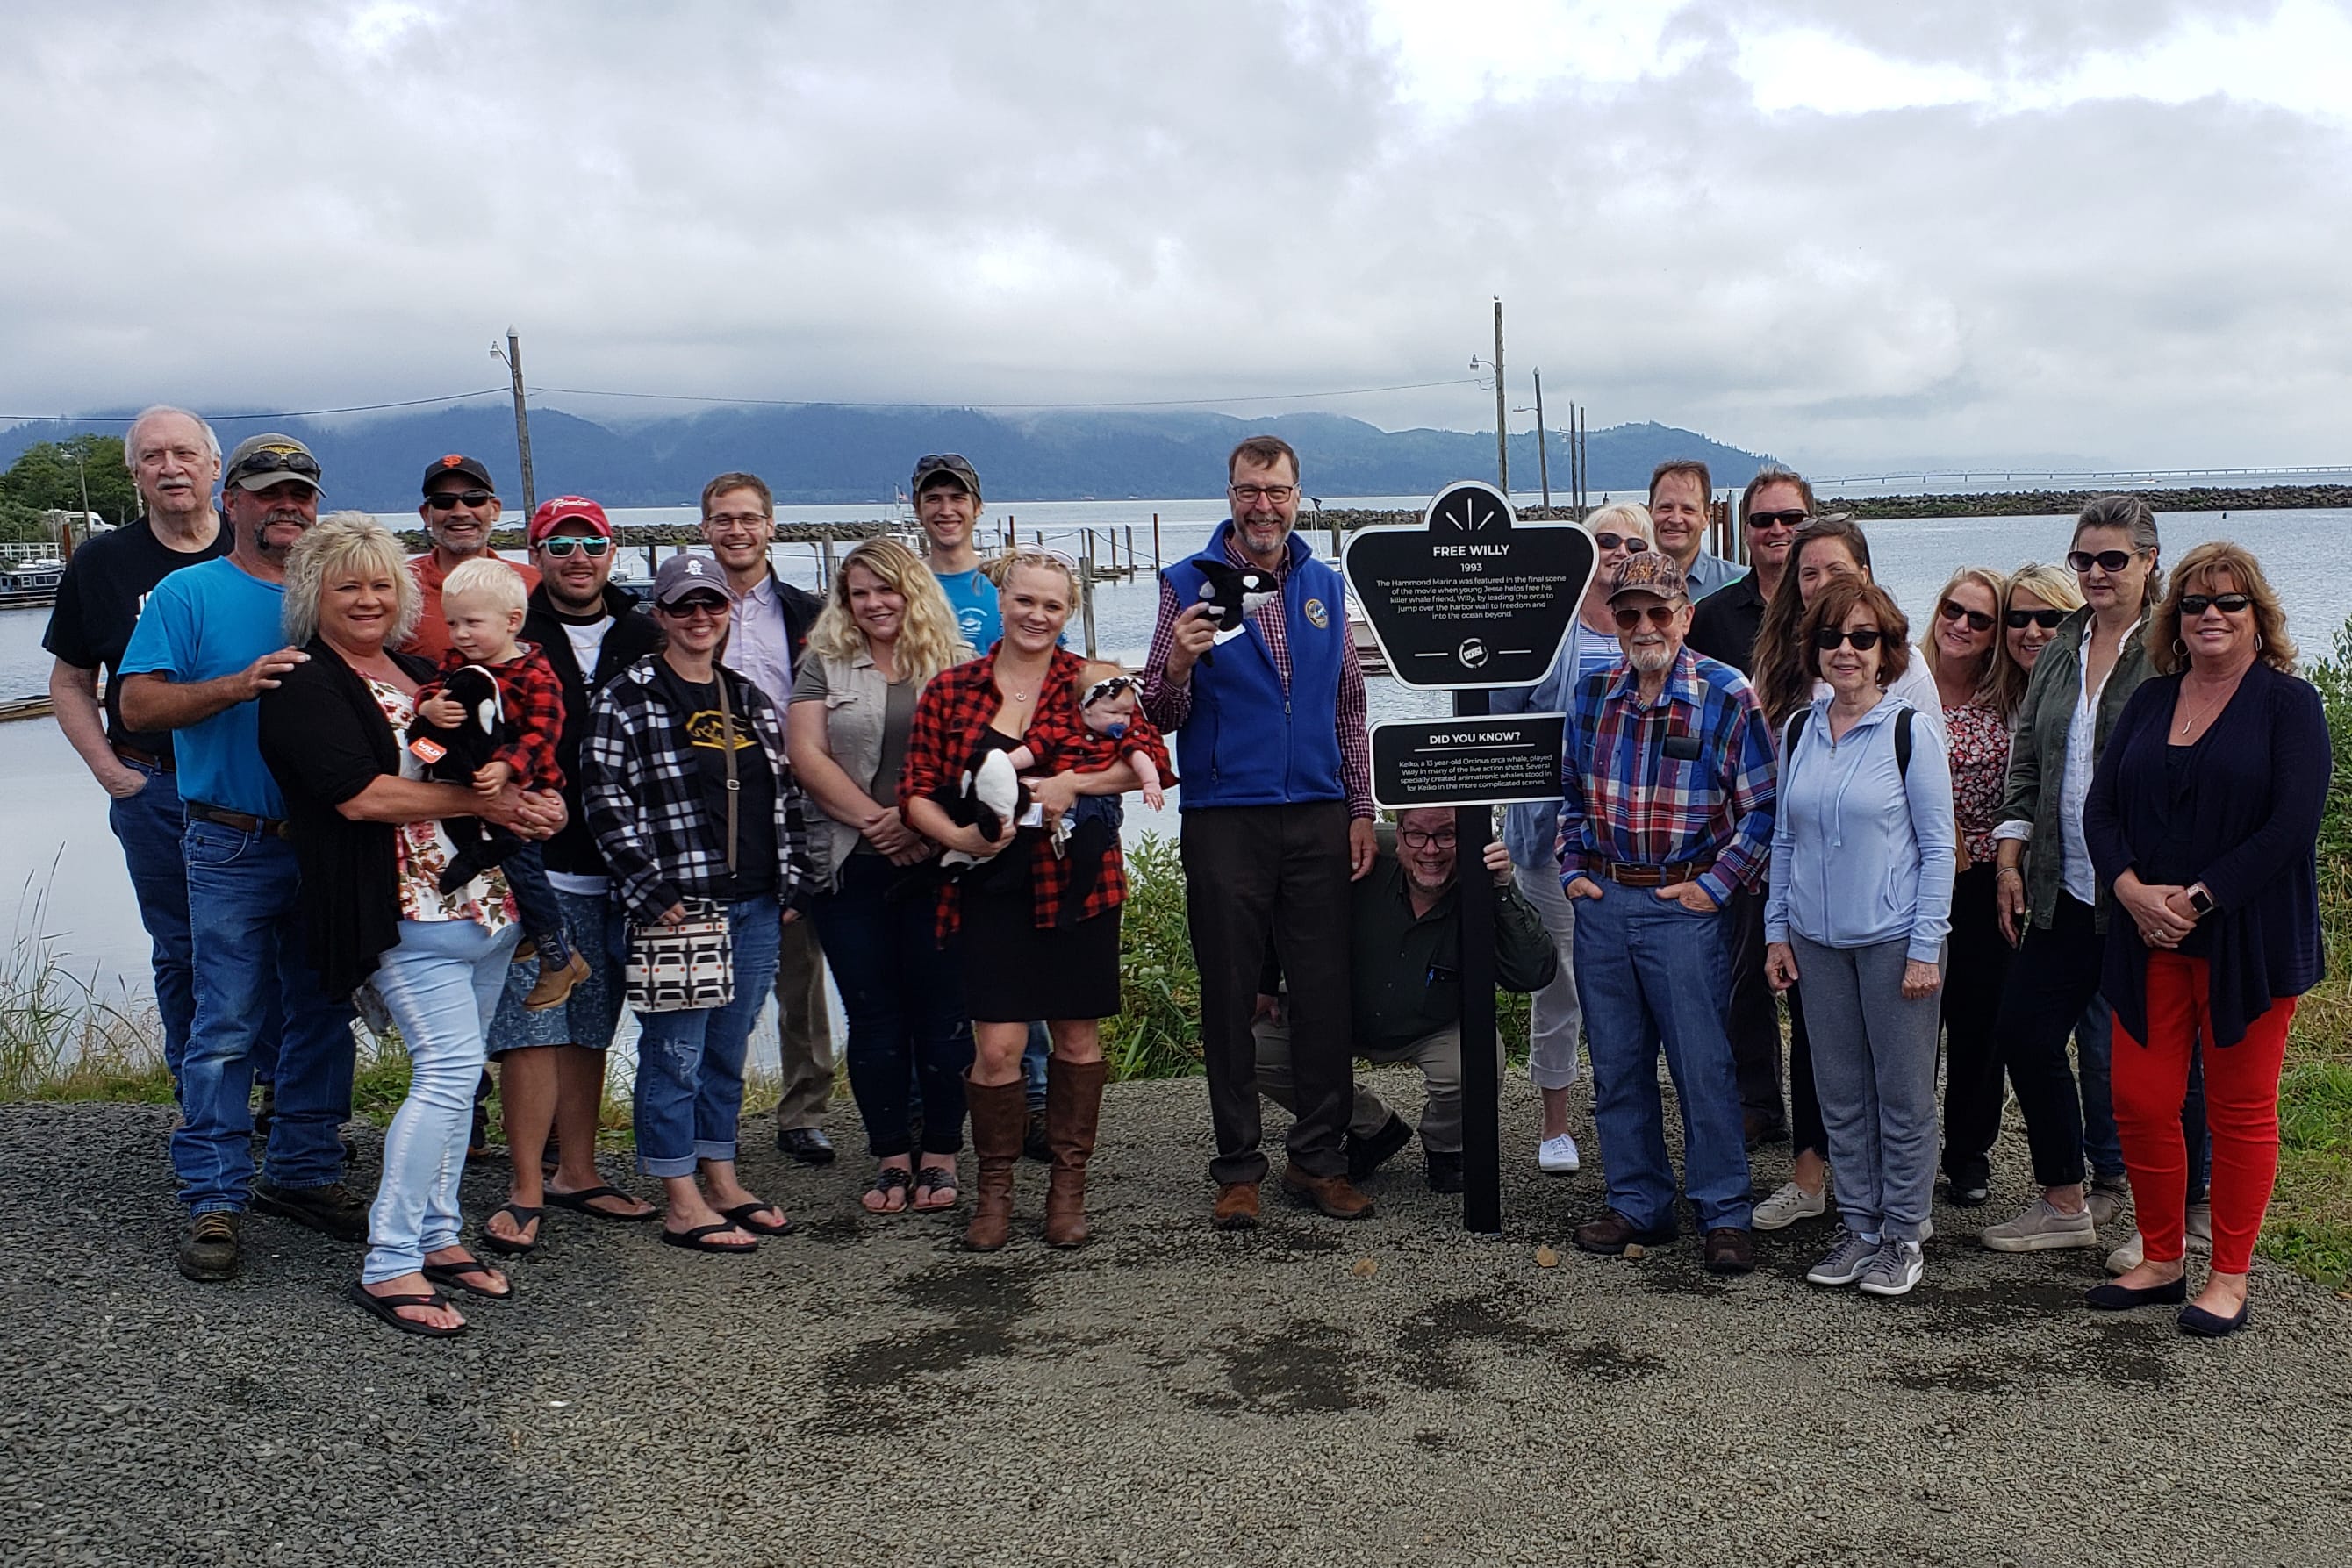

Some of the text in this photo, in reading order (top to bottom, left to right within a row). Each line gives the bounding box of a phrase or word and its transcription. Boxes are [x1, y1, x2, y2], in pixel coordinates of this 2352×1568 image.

[1433, 544, 1509, 557] FREE WILLY
[1460, 562, 1482, 573] 1993
[1485, 611, 1513, 619] beyond.
[1429, 732, 1520, 744] DID YOU KNOW?
[1434, 758, 1461, 767] year-old
[1479, 780, 1520, 788] complicated
